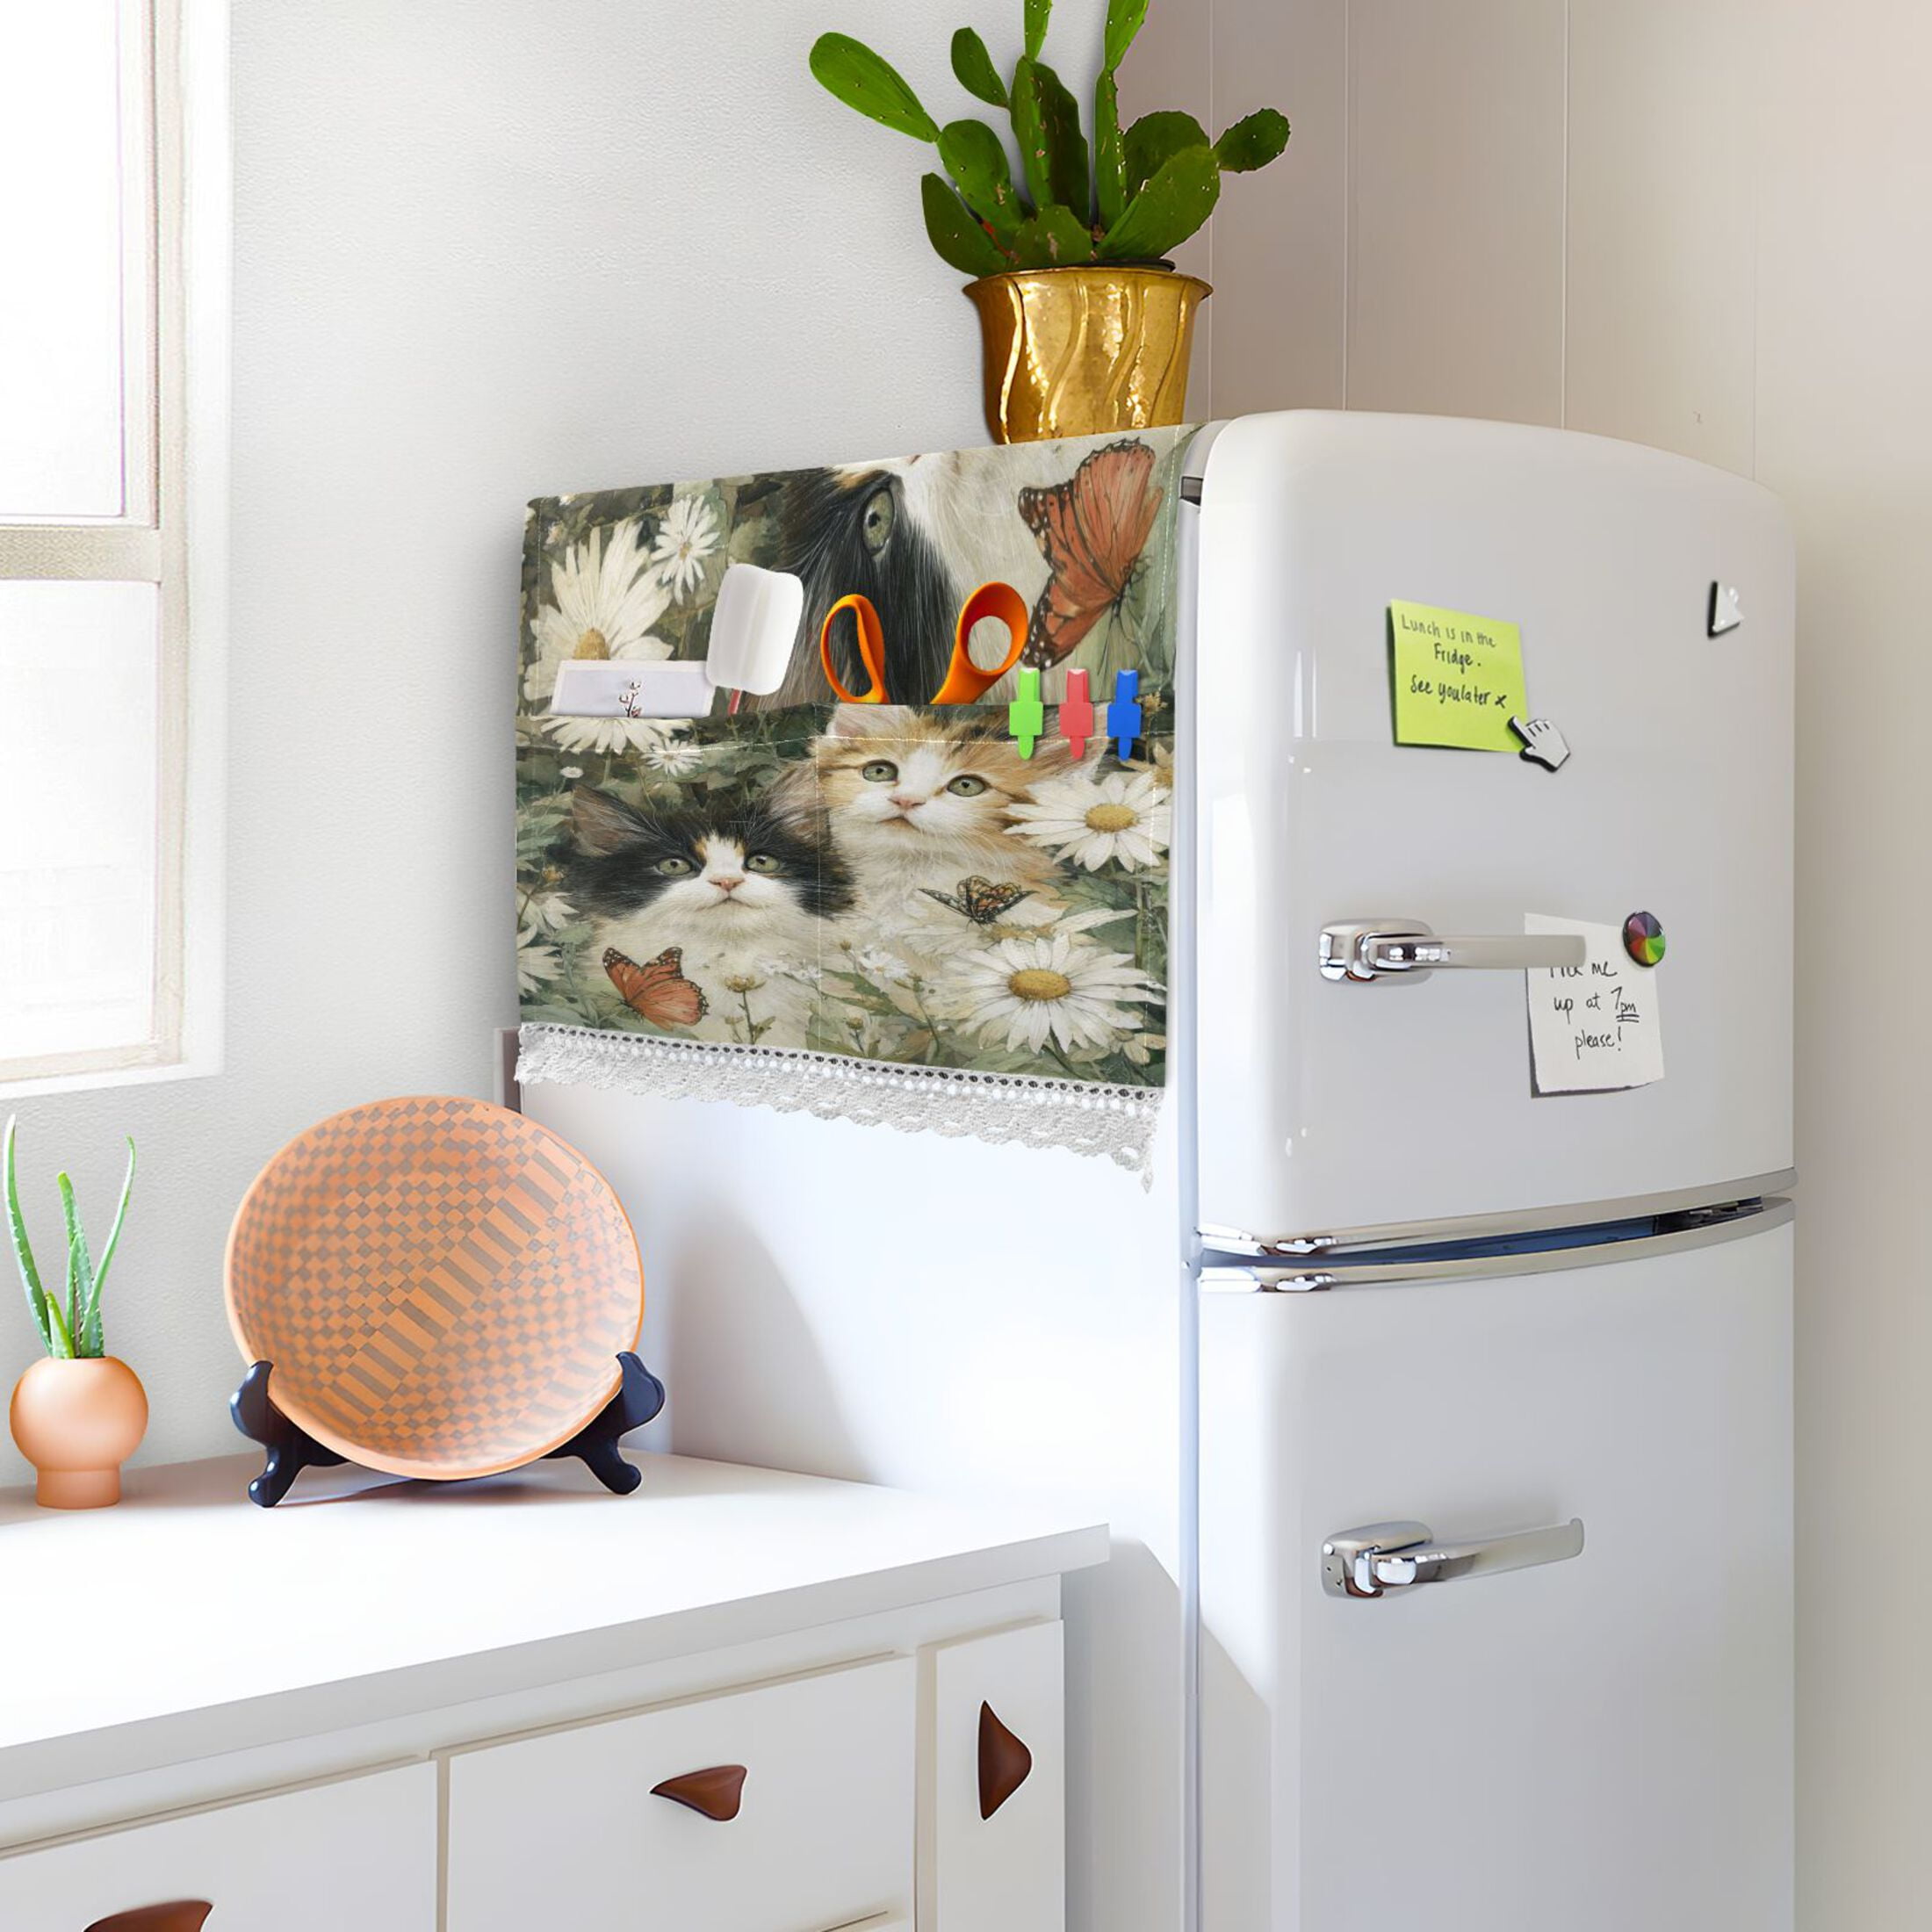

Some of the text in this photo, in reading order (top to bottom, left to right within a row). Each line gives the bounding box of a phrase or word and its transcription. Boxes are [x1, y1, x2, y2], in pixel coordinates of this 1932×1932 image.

[1402, 614, 1440, 639] Lunch
[1477, 631, 1496, 647] the
[1410, 674, 1433, 695] See
[1554, 997, 1574, 1024] up
[1586, 991, 1601, 1010] at
[1575, 1026, 1621, 1060] please!
